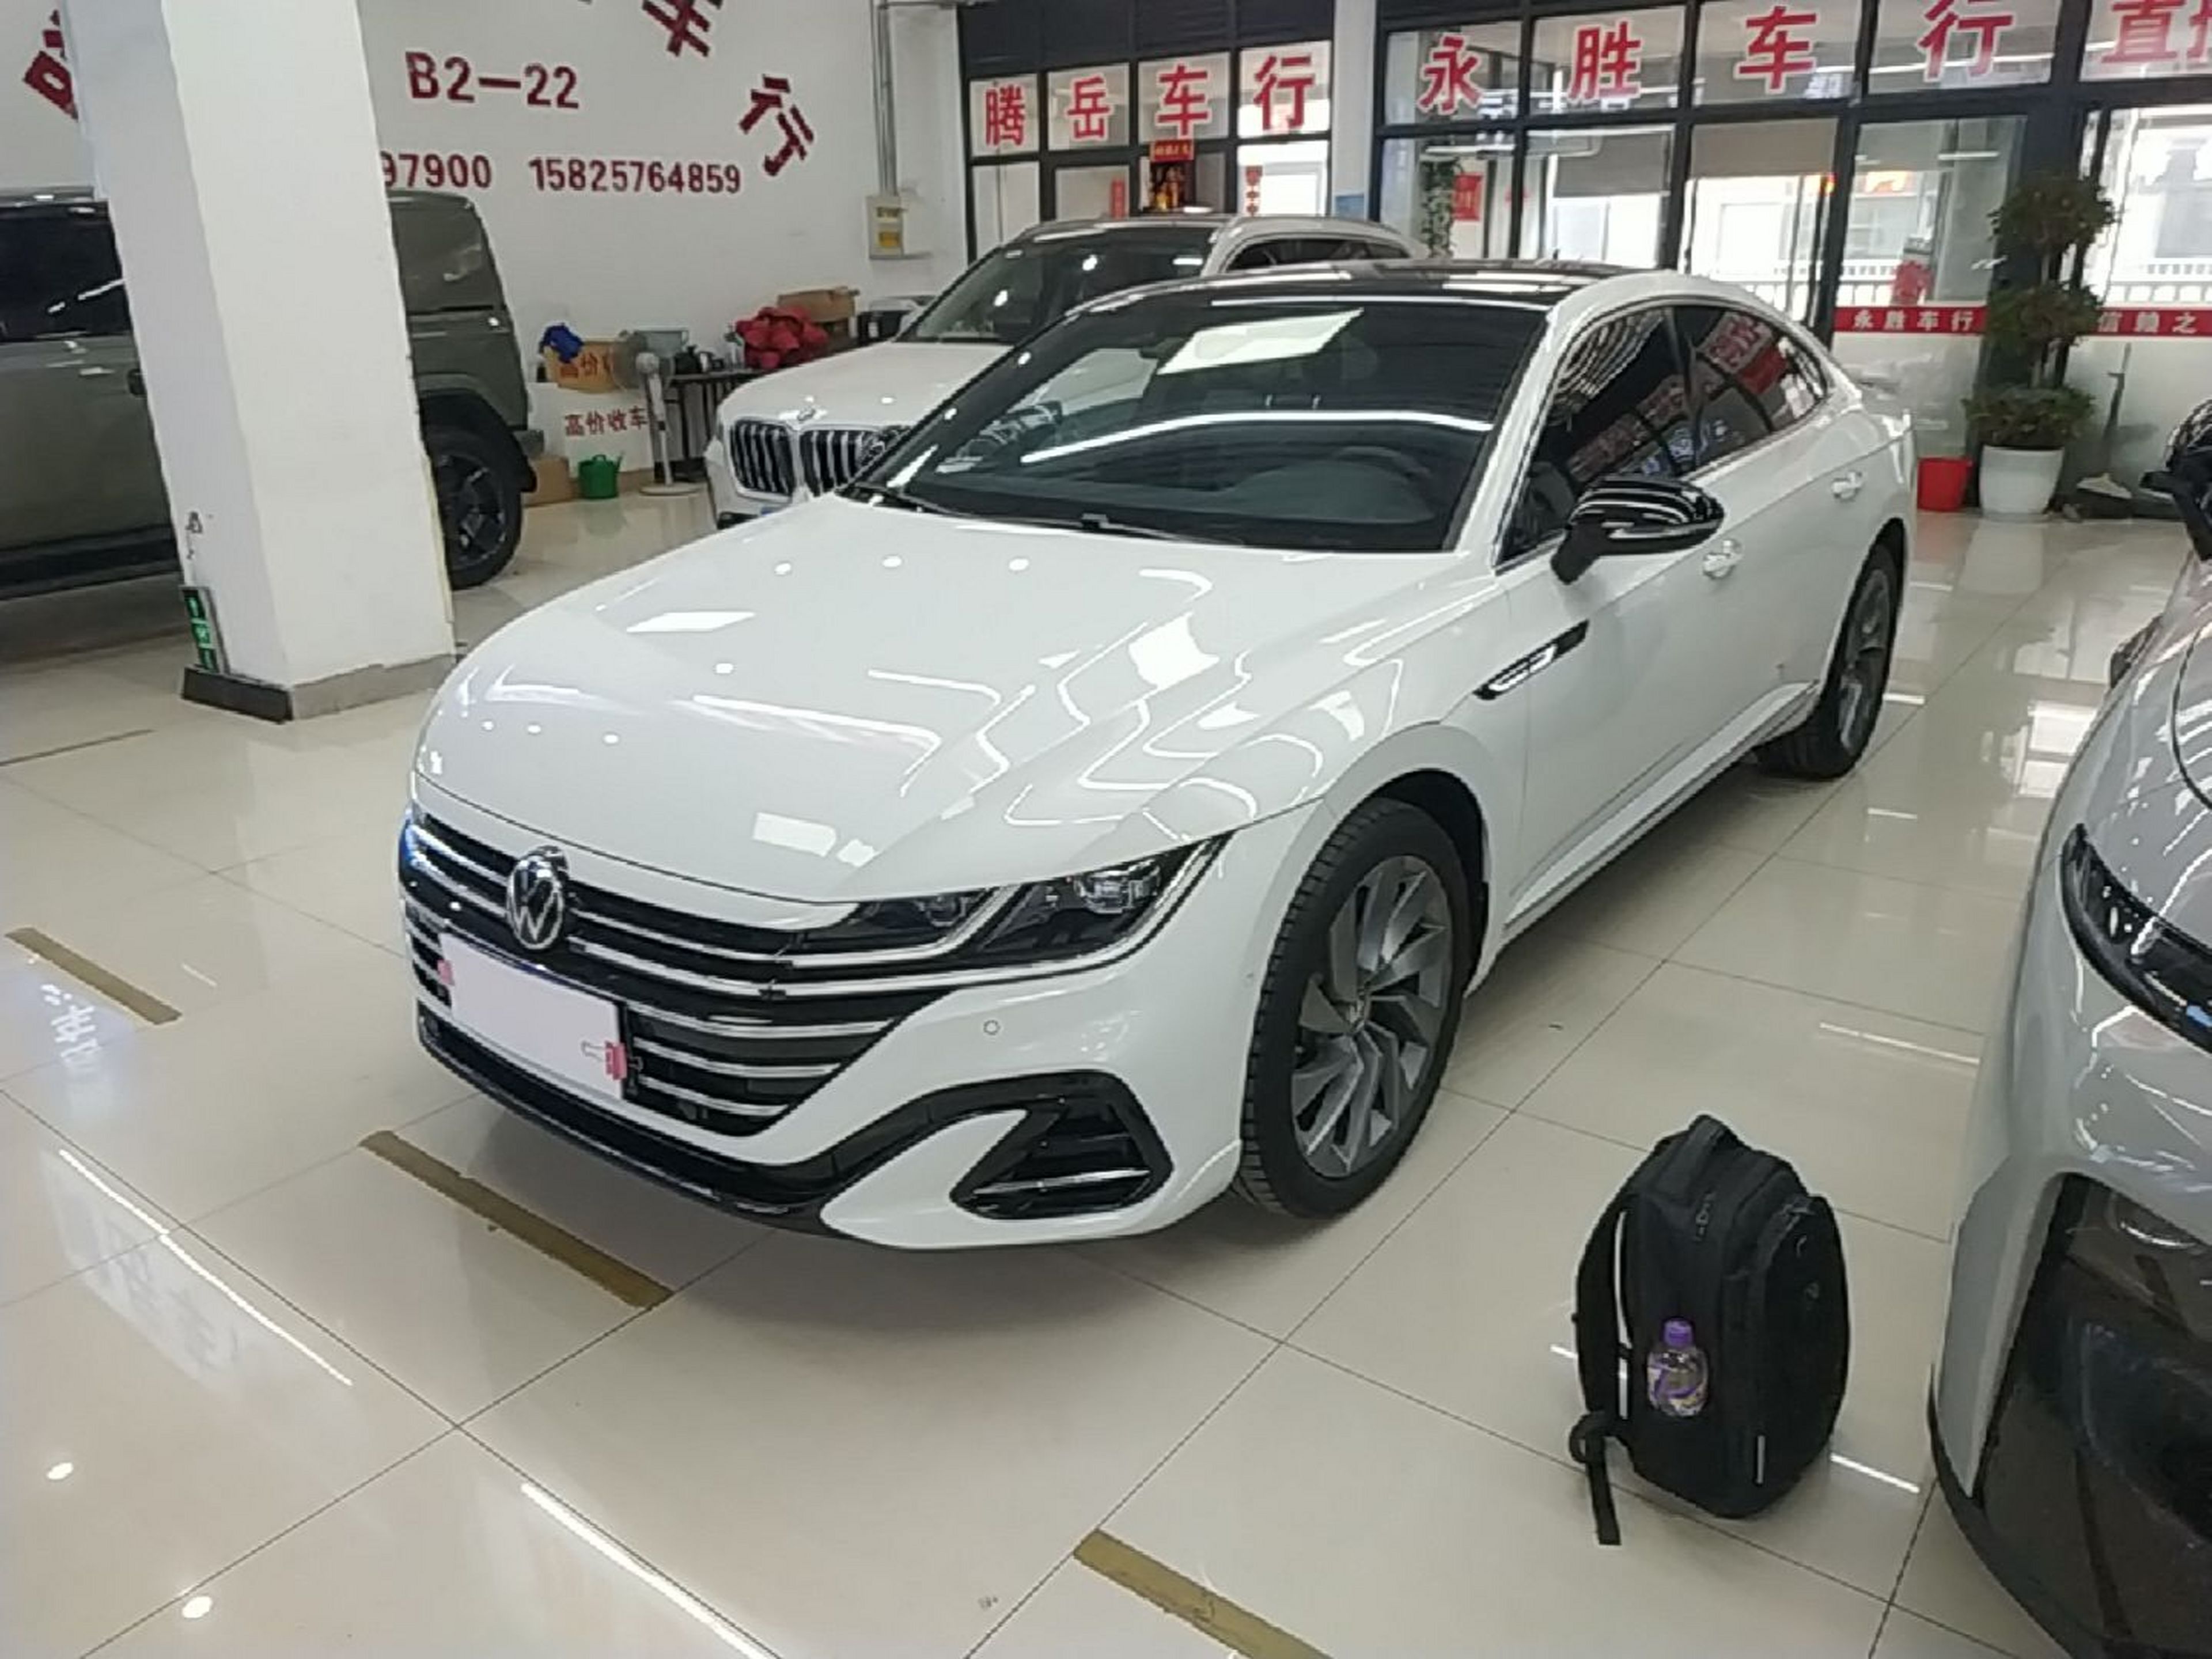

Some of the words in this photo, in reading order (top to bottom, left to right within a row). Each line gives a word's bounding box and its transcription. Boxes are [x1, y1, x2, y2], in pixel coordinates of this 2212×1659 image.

[1418, 0, 2014, 112] 永胜车行
[984, 54, 1315, 146] 腾岳车行
[528, 158, 741, 194] 15825764859
[565, 405, 647, 436] 高价收车
